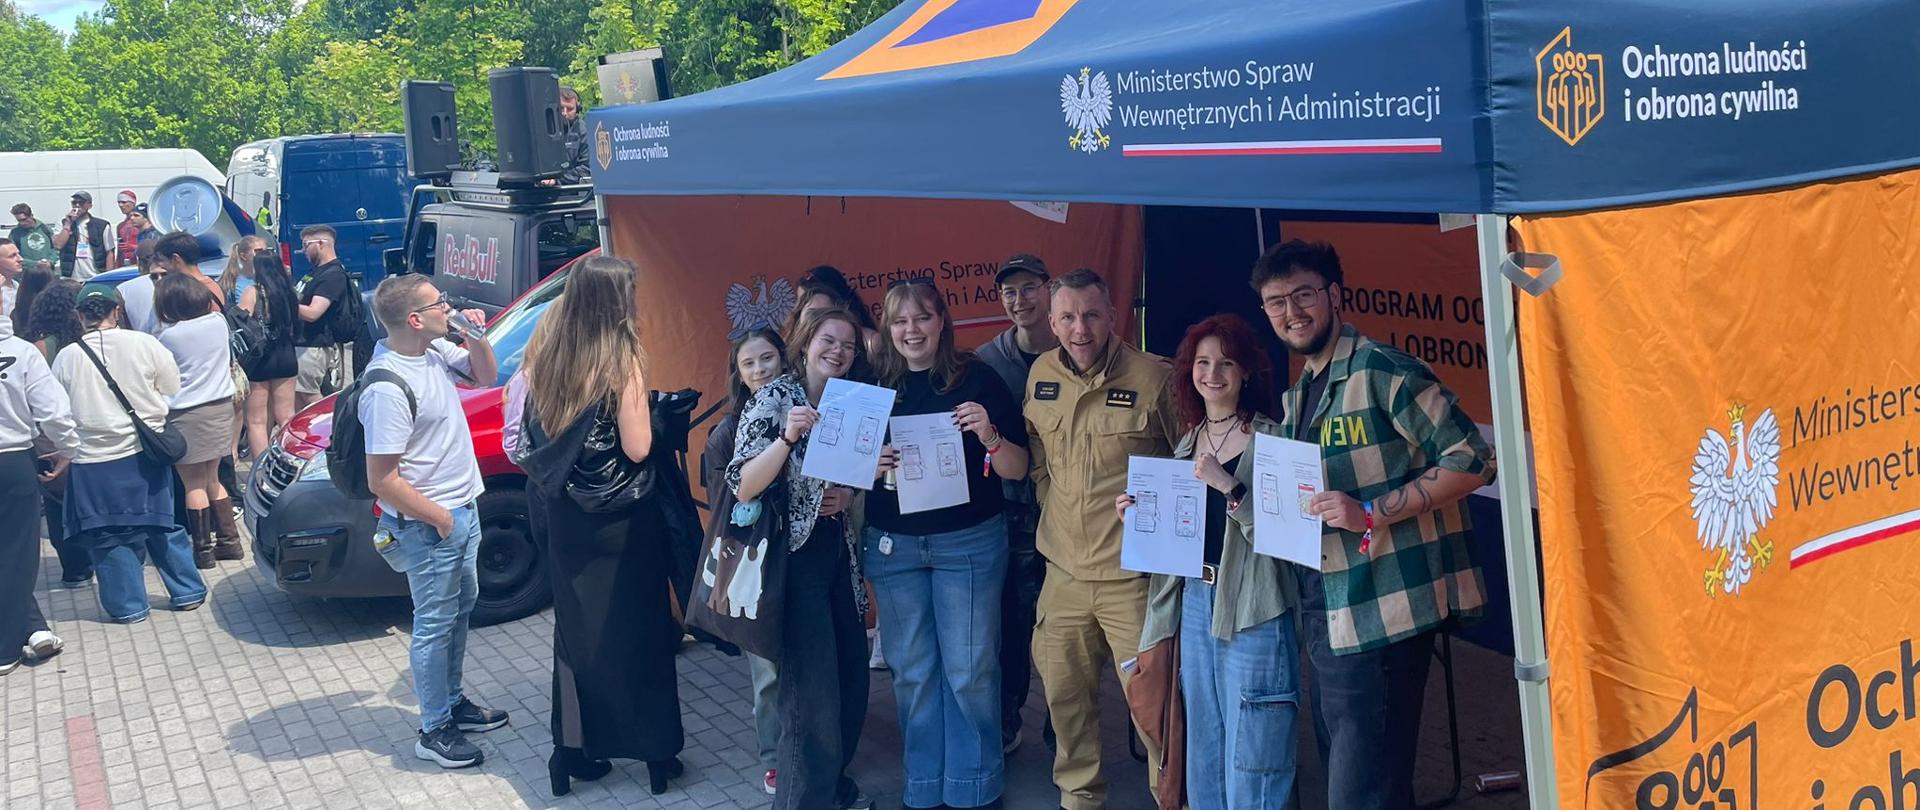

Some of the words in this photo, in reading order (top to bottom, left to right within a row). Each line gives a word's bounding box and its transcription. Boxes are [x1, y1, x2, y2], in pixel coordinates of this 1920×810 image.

[1622, 44, 1720, 79] Ochrona
[1723, 40, 1807, 74] ludności
[1117, 66, 1240, 94] Ministerstwo
[1245, 60, 1314, 90] Spraw
[1119, 97, 1262, 130] Wewnętrznych
[1267, 97, 1273, 121] i
[1278, 86, 1441, 123] Administracji
[1624, 88, 1631, 122] i
[1636, 87, 1716, 120] obrona
[1720, 80, 1798, 120] cywilna
[613, 126, 640, 142] Ochrona
[641, 121, 670, 139] ludności
[615, 146, 619, 160] i
[619, 146, 641, 160] obrona
[641, 142, 669, 162] cywilna
[940, 261, 998, 282] Spraw
[1341, 287, 1444, 321] ROGRAM
[1789, 440, 1920, 512] Wewnęt
